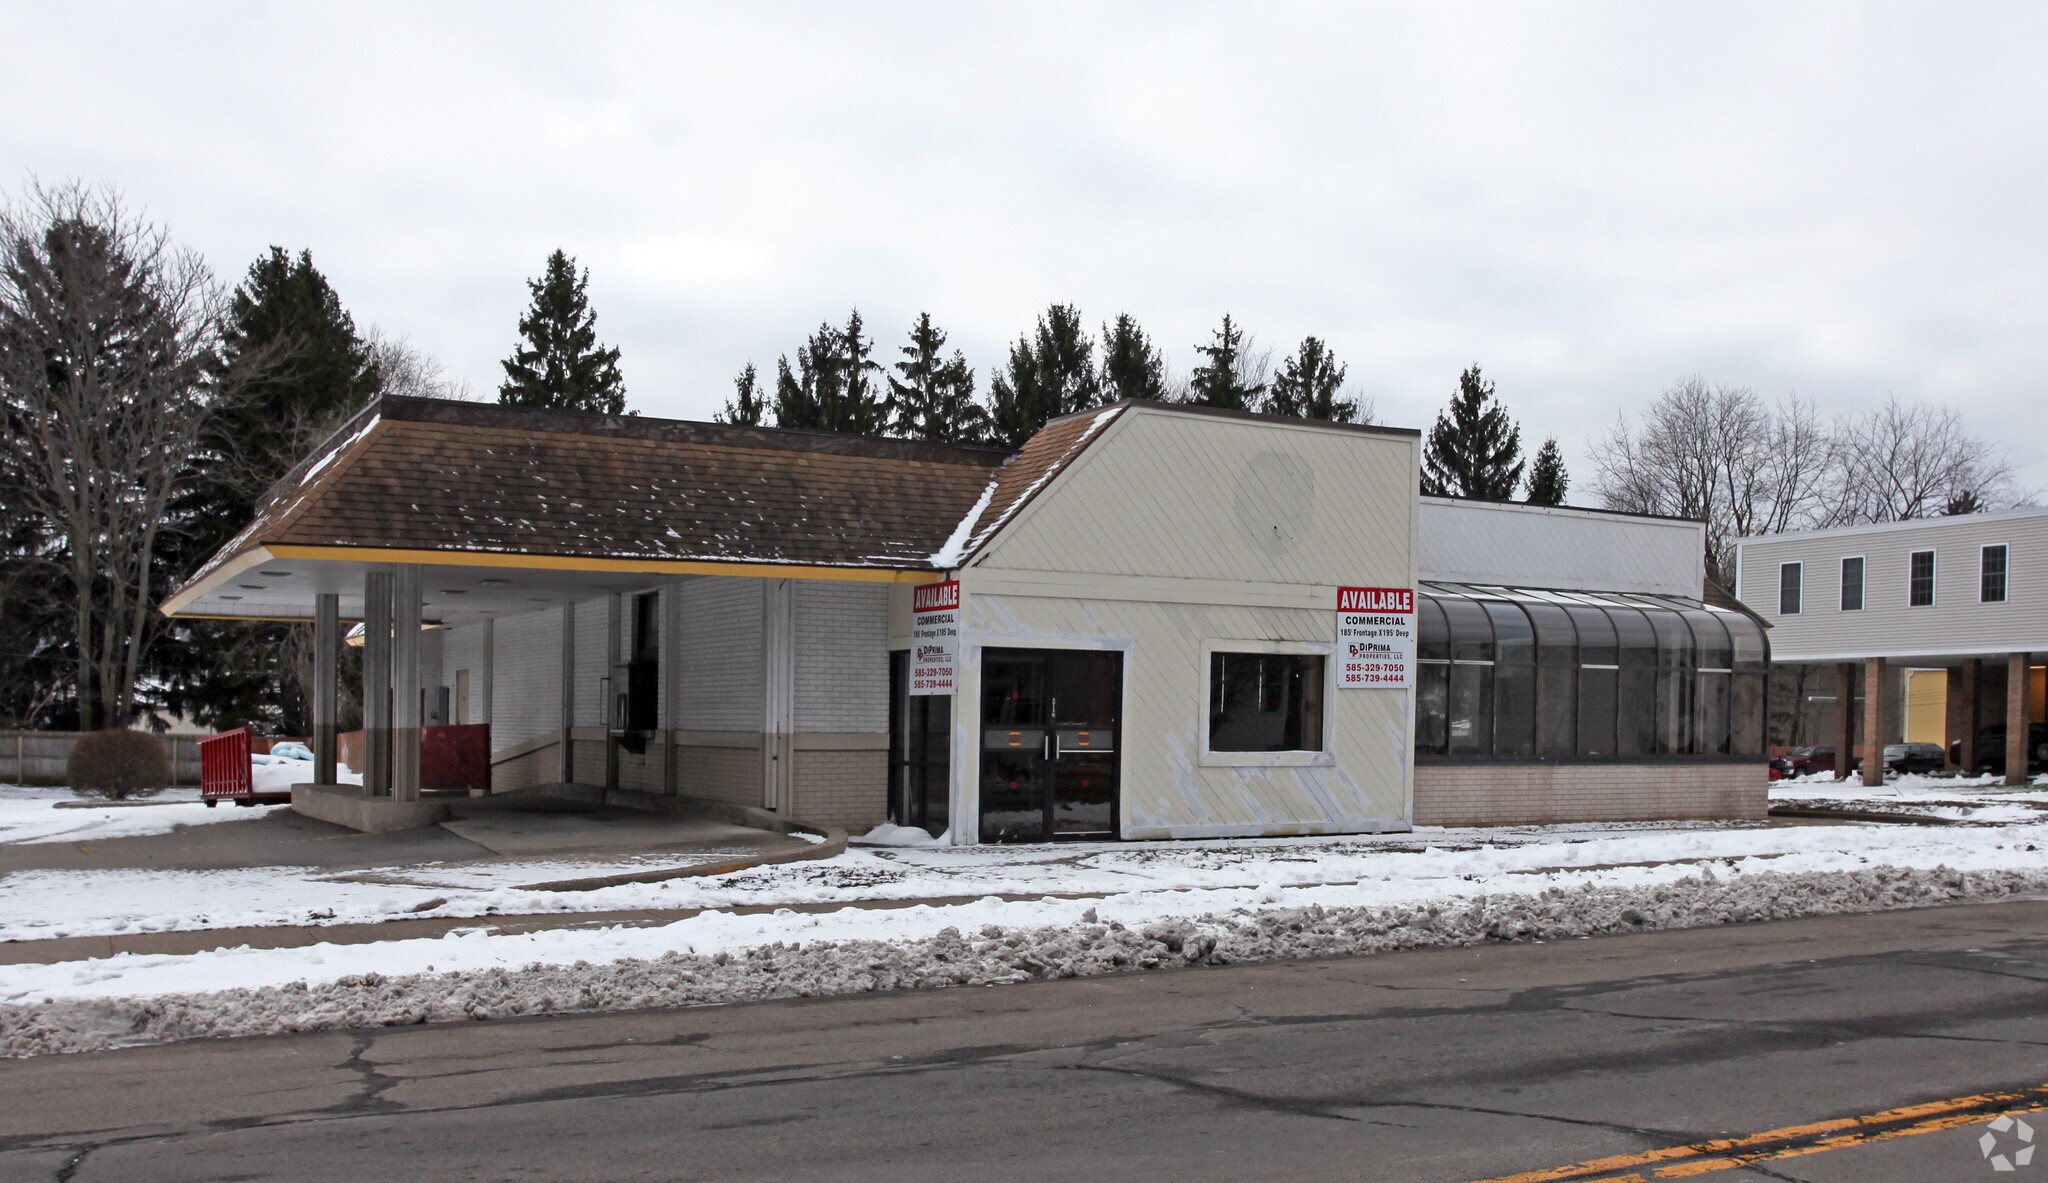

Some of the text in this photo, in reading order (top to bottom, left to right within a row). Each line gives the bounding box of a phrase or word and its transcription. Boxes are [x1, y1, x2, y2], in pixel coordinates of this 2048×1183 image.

[915, 585, 958, 609] AVAILABLE
[1340, 590, 1411, 611] AVAILABLE
[917, 613, 955, 626] COMMERCIAL
[1345, 615, 1406, 626] COMMERCIAL
[947, 628, 956, 637] Deep
[1353, 629, 1377, 638] Frontage
[1395, 629, 1409, 638] Deep
[914, 667, 953, 677] 585-329-7050
[1345, 663, 1405, 672] 585-329-7050
[1345, 673, 1405, 682] 585-739-4444
[914, 679, 953, 689] 585-739-4444
